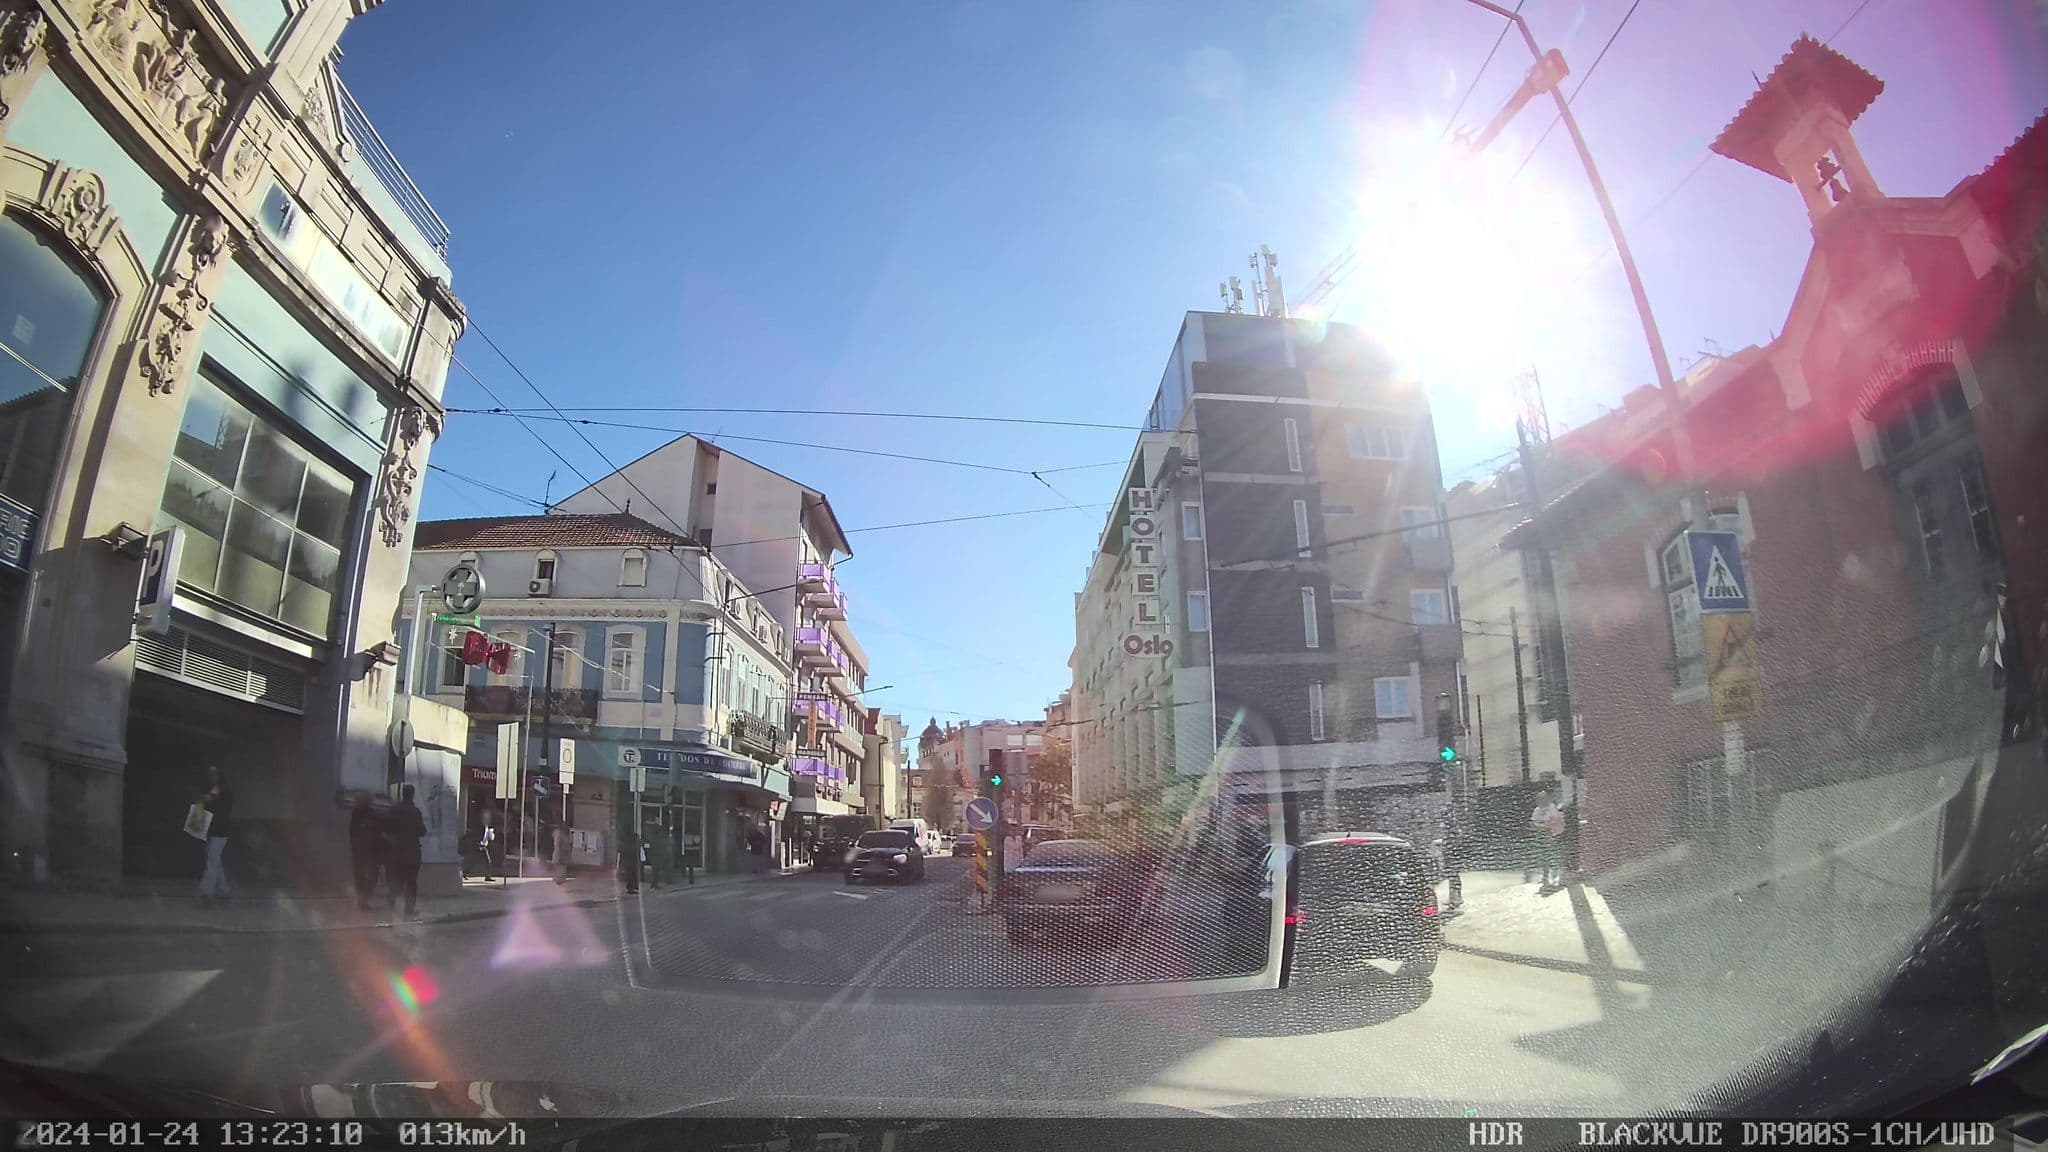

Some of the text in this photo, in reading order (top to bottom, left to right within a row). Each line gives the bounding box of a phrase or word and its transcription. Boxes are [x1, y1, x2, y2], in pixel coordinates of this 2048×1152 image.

[142, 539, 165, 598] P
[1131, 490, 1156, 621] HOTEL
[1124, 635, 1174, 656] Oslo
[473, 768, 497, 780] Trium
